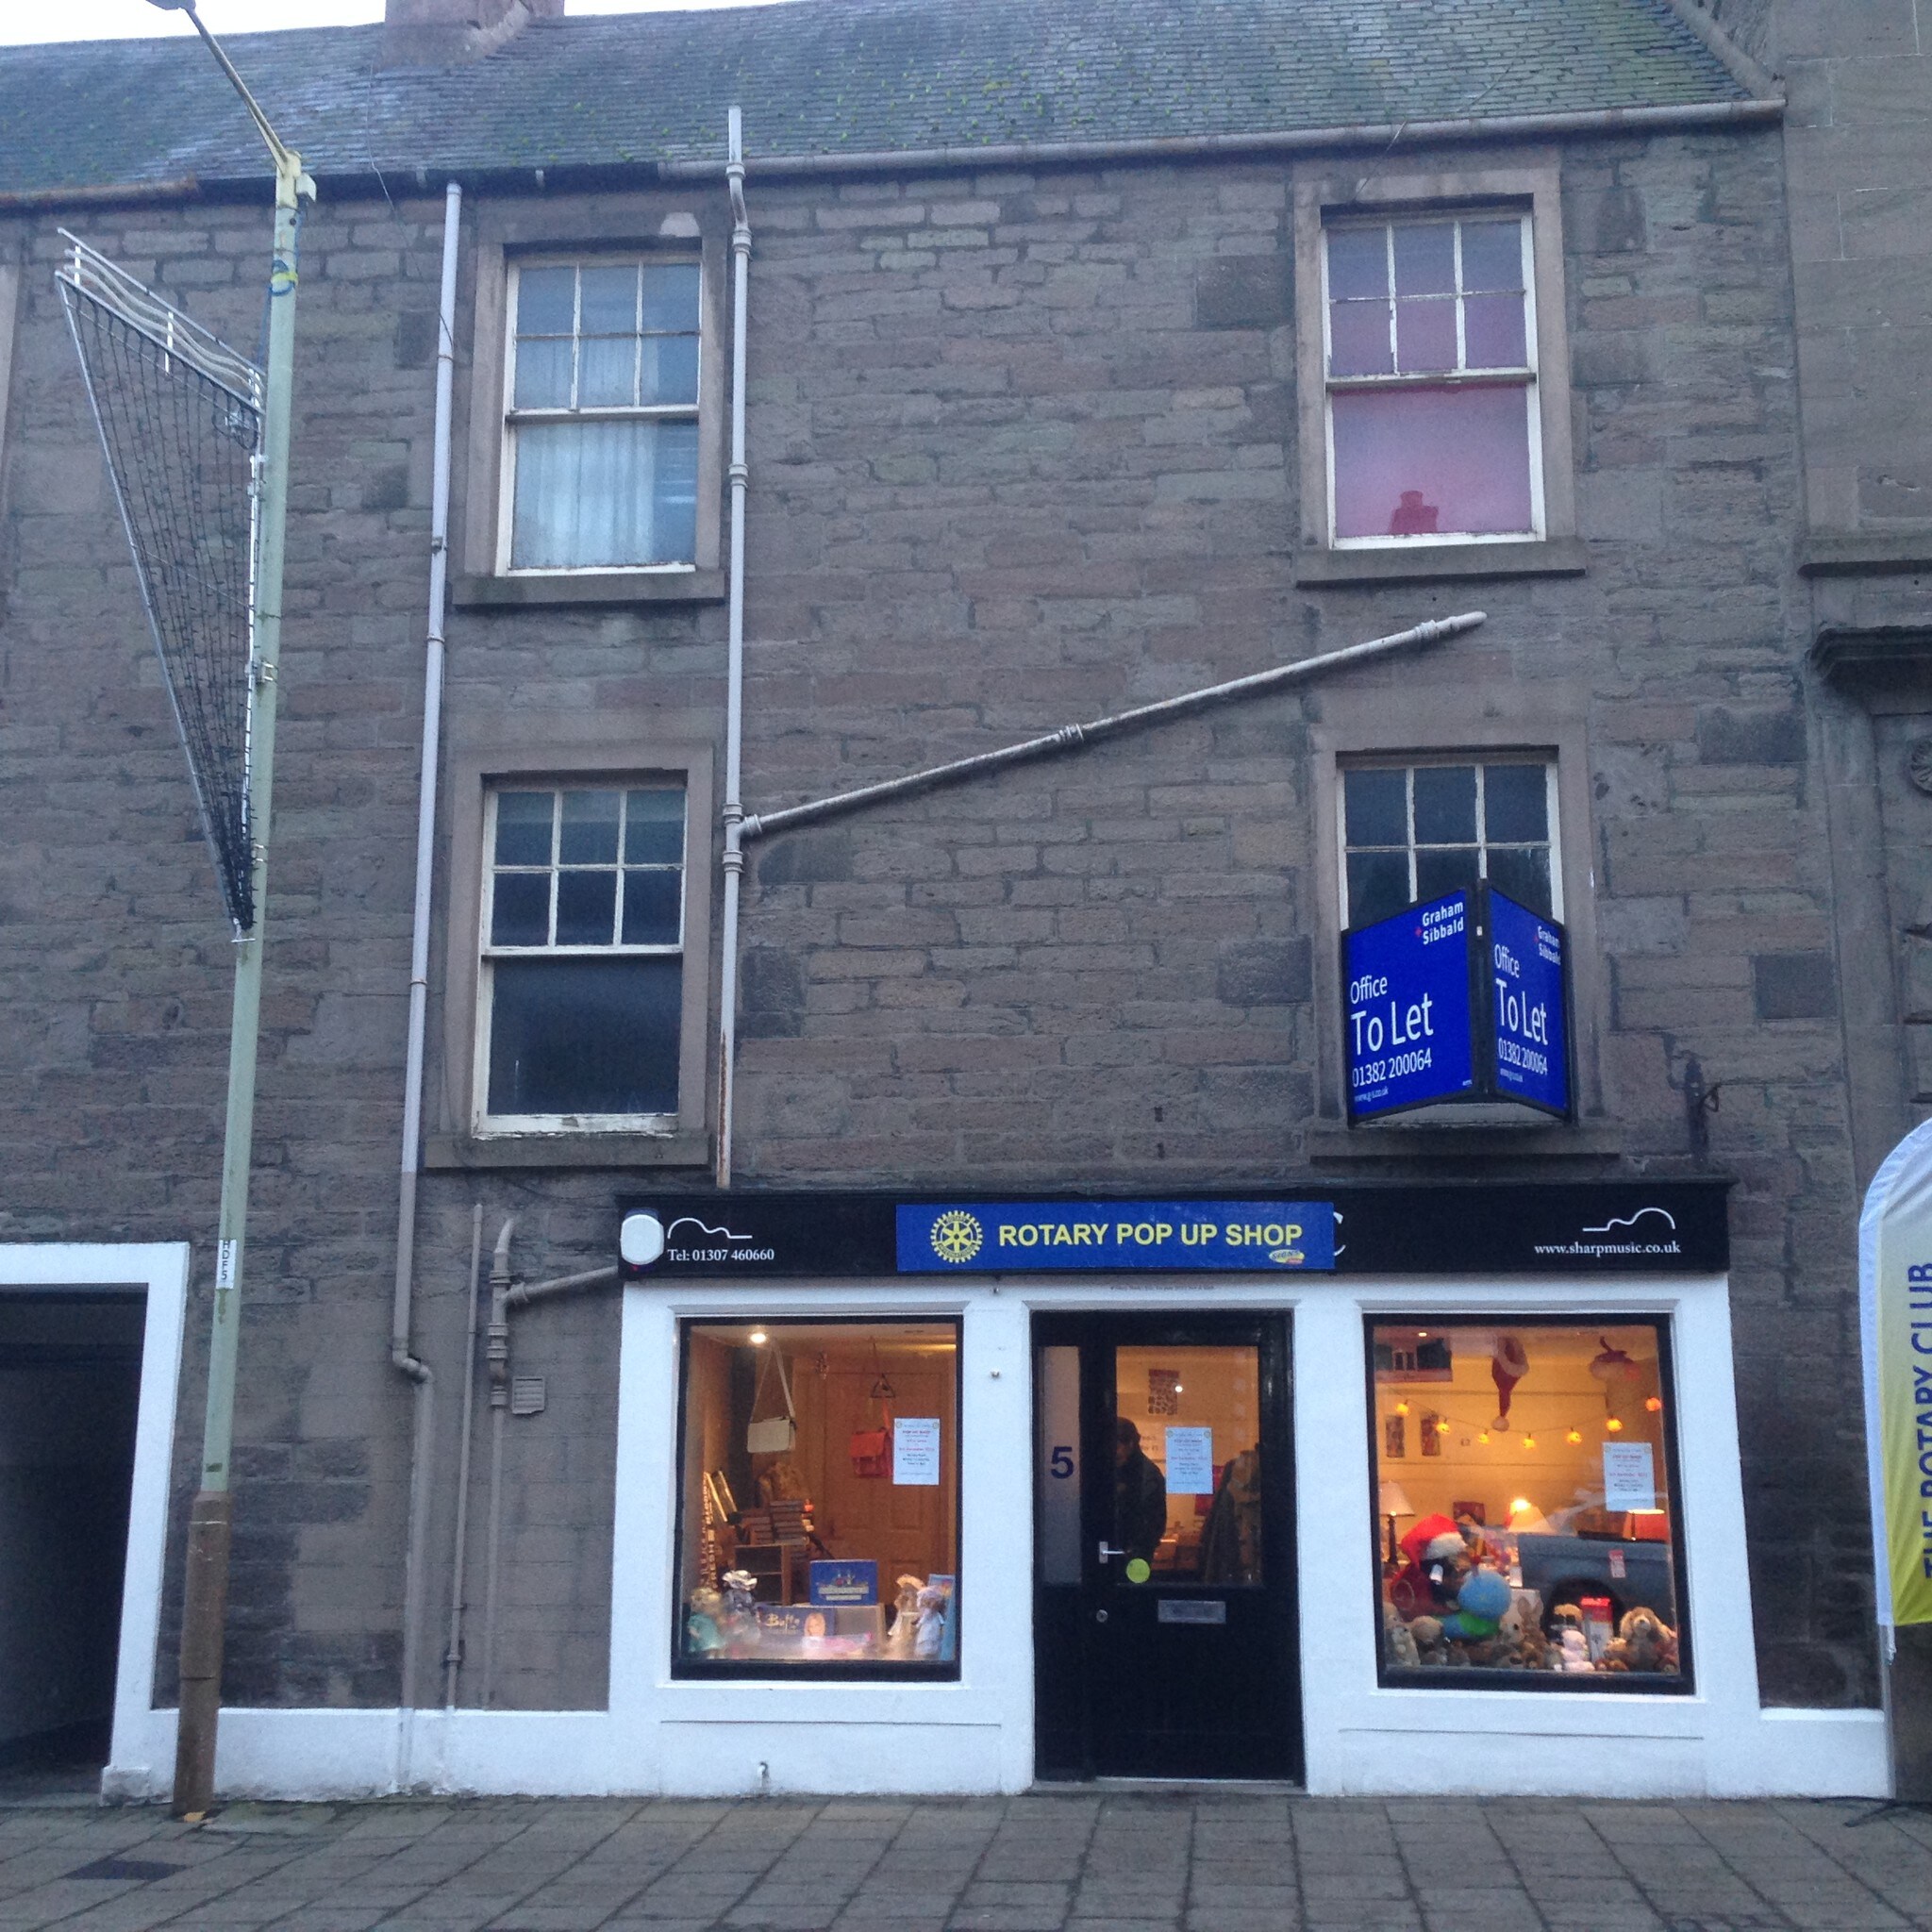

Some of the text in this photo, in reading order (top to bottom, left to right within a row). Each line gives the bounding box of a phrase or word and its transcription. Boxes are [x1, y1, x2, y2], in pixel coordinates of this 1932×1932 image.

[1422, 901, 1463, 927] Graham
[1423, 917, 1464, 945] Sibbald
[1494, 943, 1520, 978] Office
[1350, 974, 1388, 1005] Office
[1350, 992, 1434, 1056] To Let
[1495, 977, 1548, 1046] To Let
[1352, 1047, 1432, 1088] 01382 200064
[1498, 1037, 1522, 1066] 01382
[1522, 1046, 1548, 1076] 200064
[999, 1223, 1303, 1246] ROTARY POP UP SHOP
[1534, 1241, 1681, 1257] www.sharpmusic.co.uk
[667, 1248, 774, 1261] Tel: 01307 460660
[1050, 1446, 1074, 1479] 5
